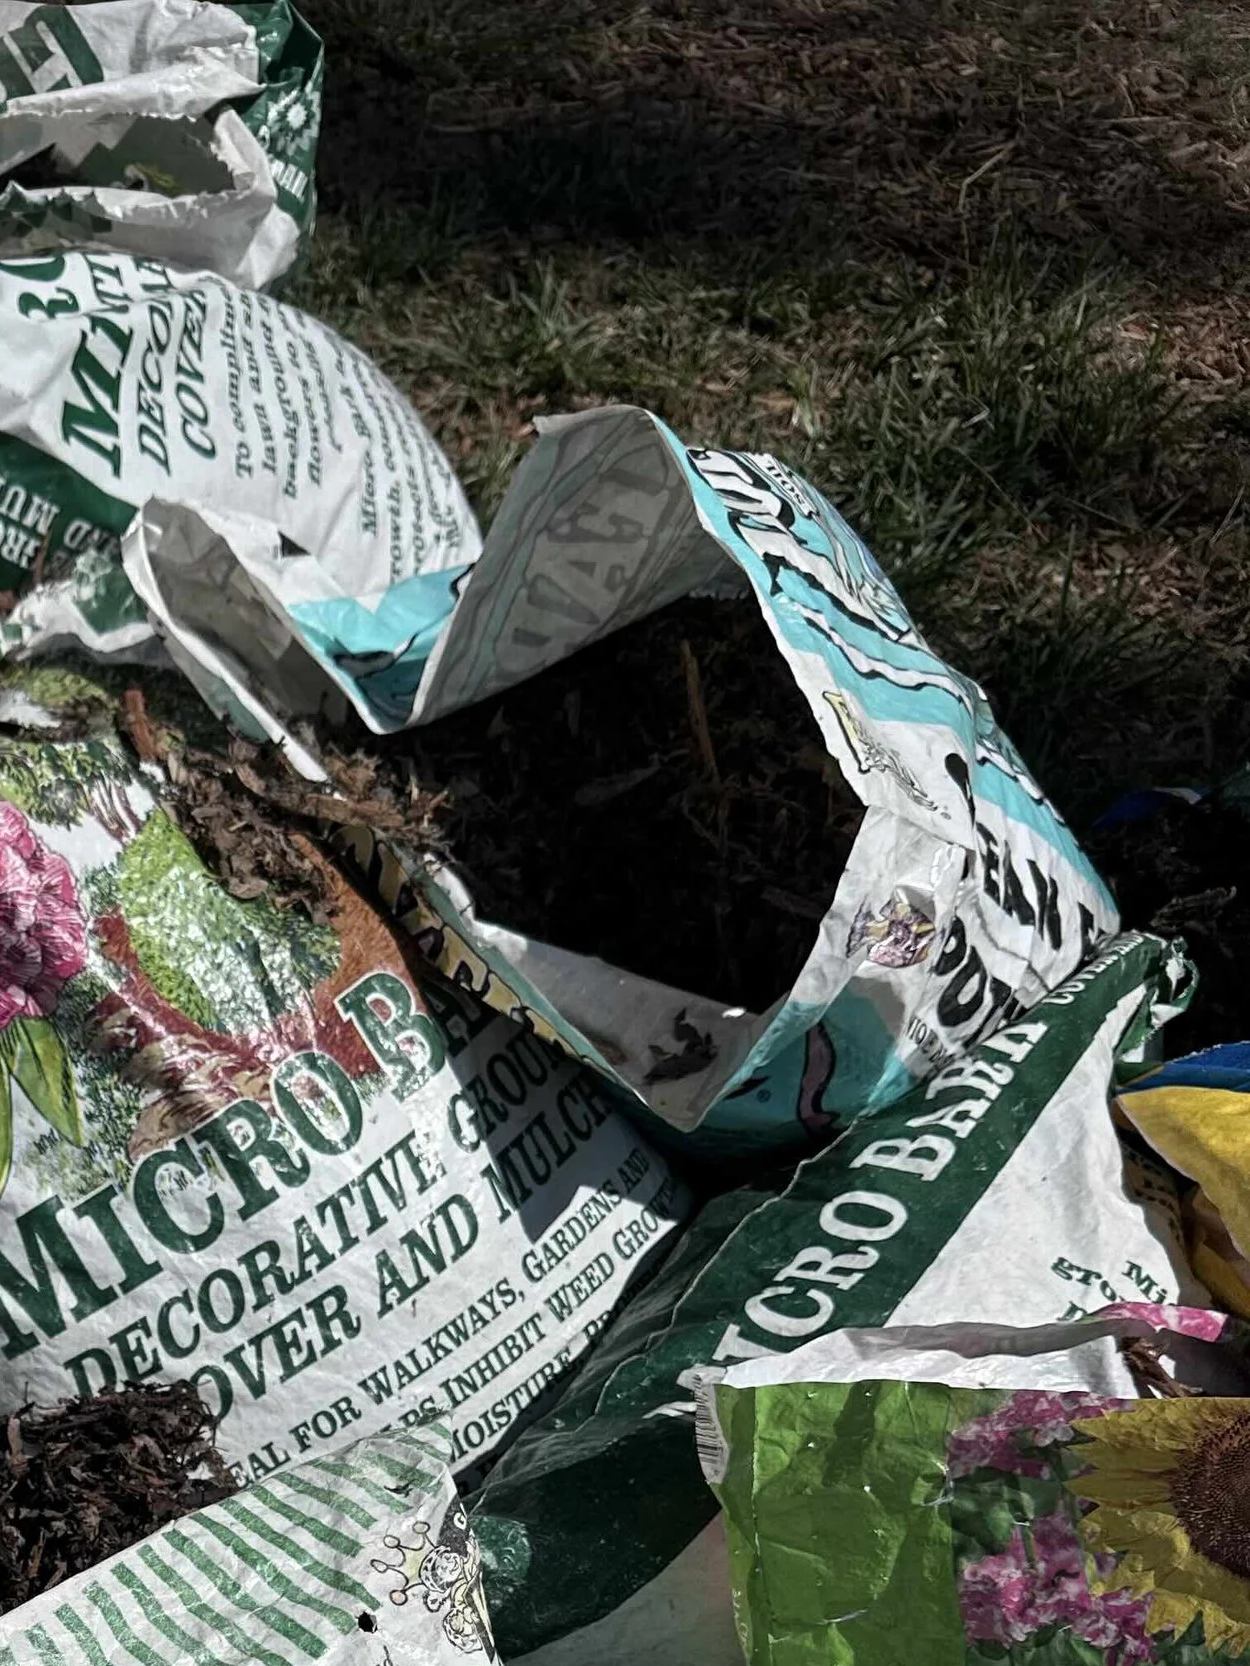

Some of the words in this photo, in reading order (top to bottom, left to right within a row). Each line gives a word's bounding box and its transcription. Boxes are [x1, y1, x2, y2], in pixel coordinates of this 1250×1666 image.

[252, 402, 279, 477] lawn
[377, 1192, 479, 1318] AND
[479, 1072, 617, 1224] MULCH
[847, 1019, 1051, 1183] BARK
[64, 1127, 452, 1399] DECORATIVE
[289, 1396, 363, 1455] FOR
[357, 1276, 526, 1406] WALKWAYS,
[521, 1182, 623, 1284] GARDENS
[616, 1147, 650, 1190] AND
[439, 1312, 547, 1410] INHIBIT
[546, 1248, 617, 1324] WEED
